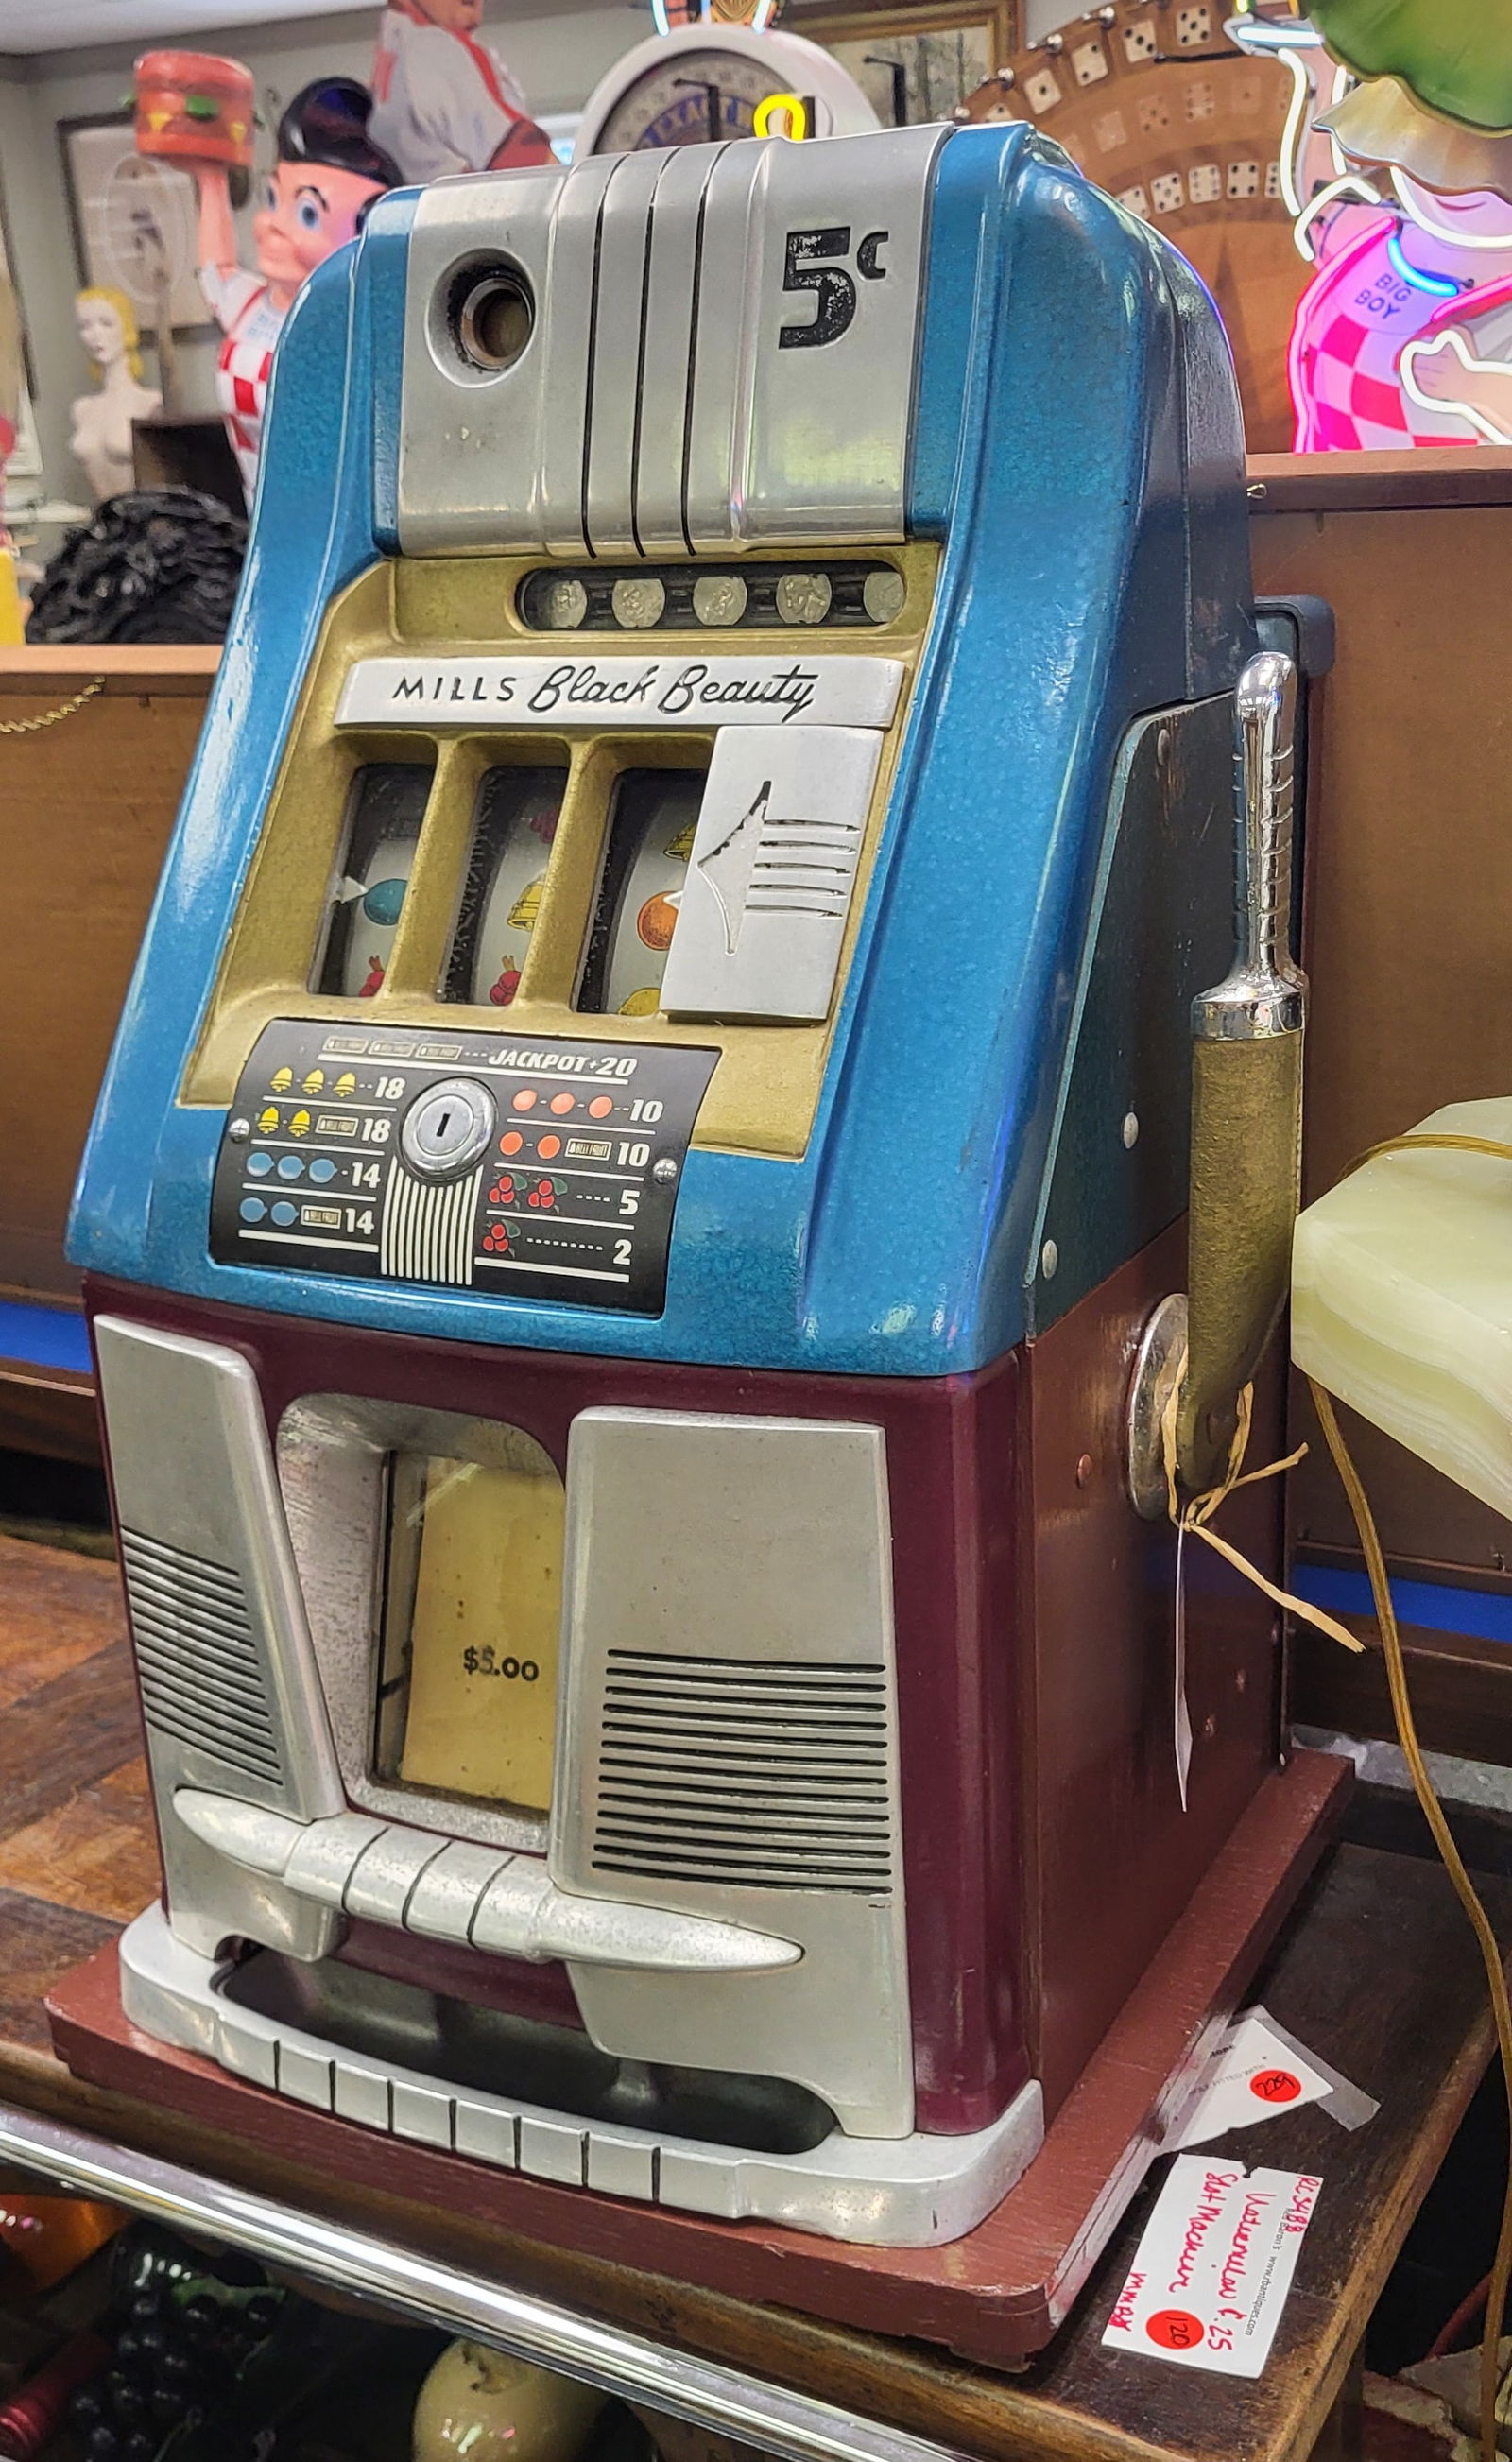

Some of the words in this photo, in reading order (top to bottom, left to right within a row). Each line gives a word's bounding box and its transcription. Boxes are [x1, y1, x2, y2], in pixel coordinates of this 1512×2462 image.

[1374, 273, 1412, 302] BIG
[1354, 288, 1401, 319] BOY
[392, 676, 517, 702] MILLS
[527, 664, 660, 714] Black
[658, 663, 819, 723] Beauty
[375, 1076, 406, 1100] 18
[628, 1098, 663, 1123] 10
[361, 1118, 391, 1143] 18
[617, 1142, 650, 1167] 10
[352, 1162, 381, 1189] 14
[618, 1189, 641, 1215] 5
[345, 1208, 375, 1234] 14
[612, 1238, 632, 1265] 2
[1205, 2171, 1239, 2206] Slot
[1244, 2256, 1276, 2336] www.rbantiques.com
[1165, 2316, 1192, 2347] 120
